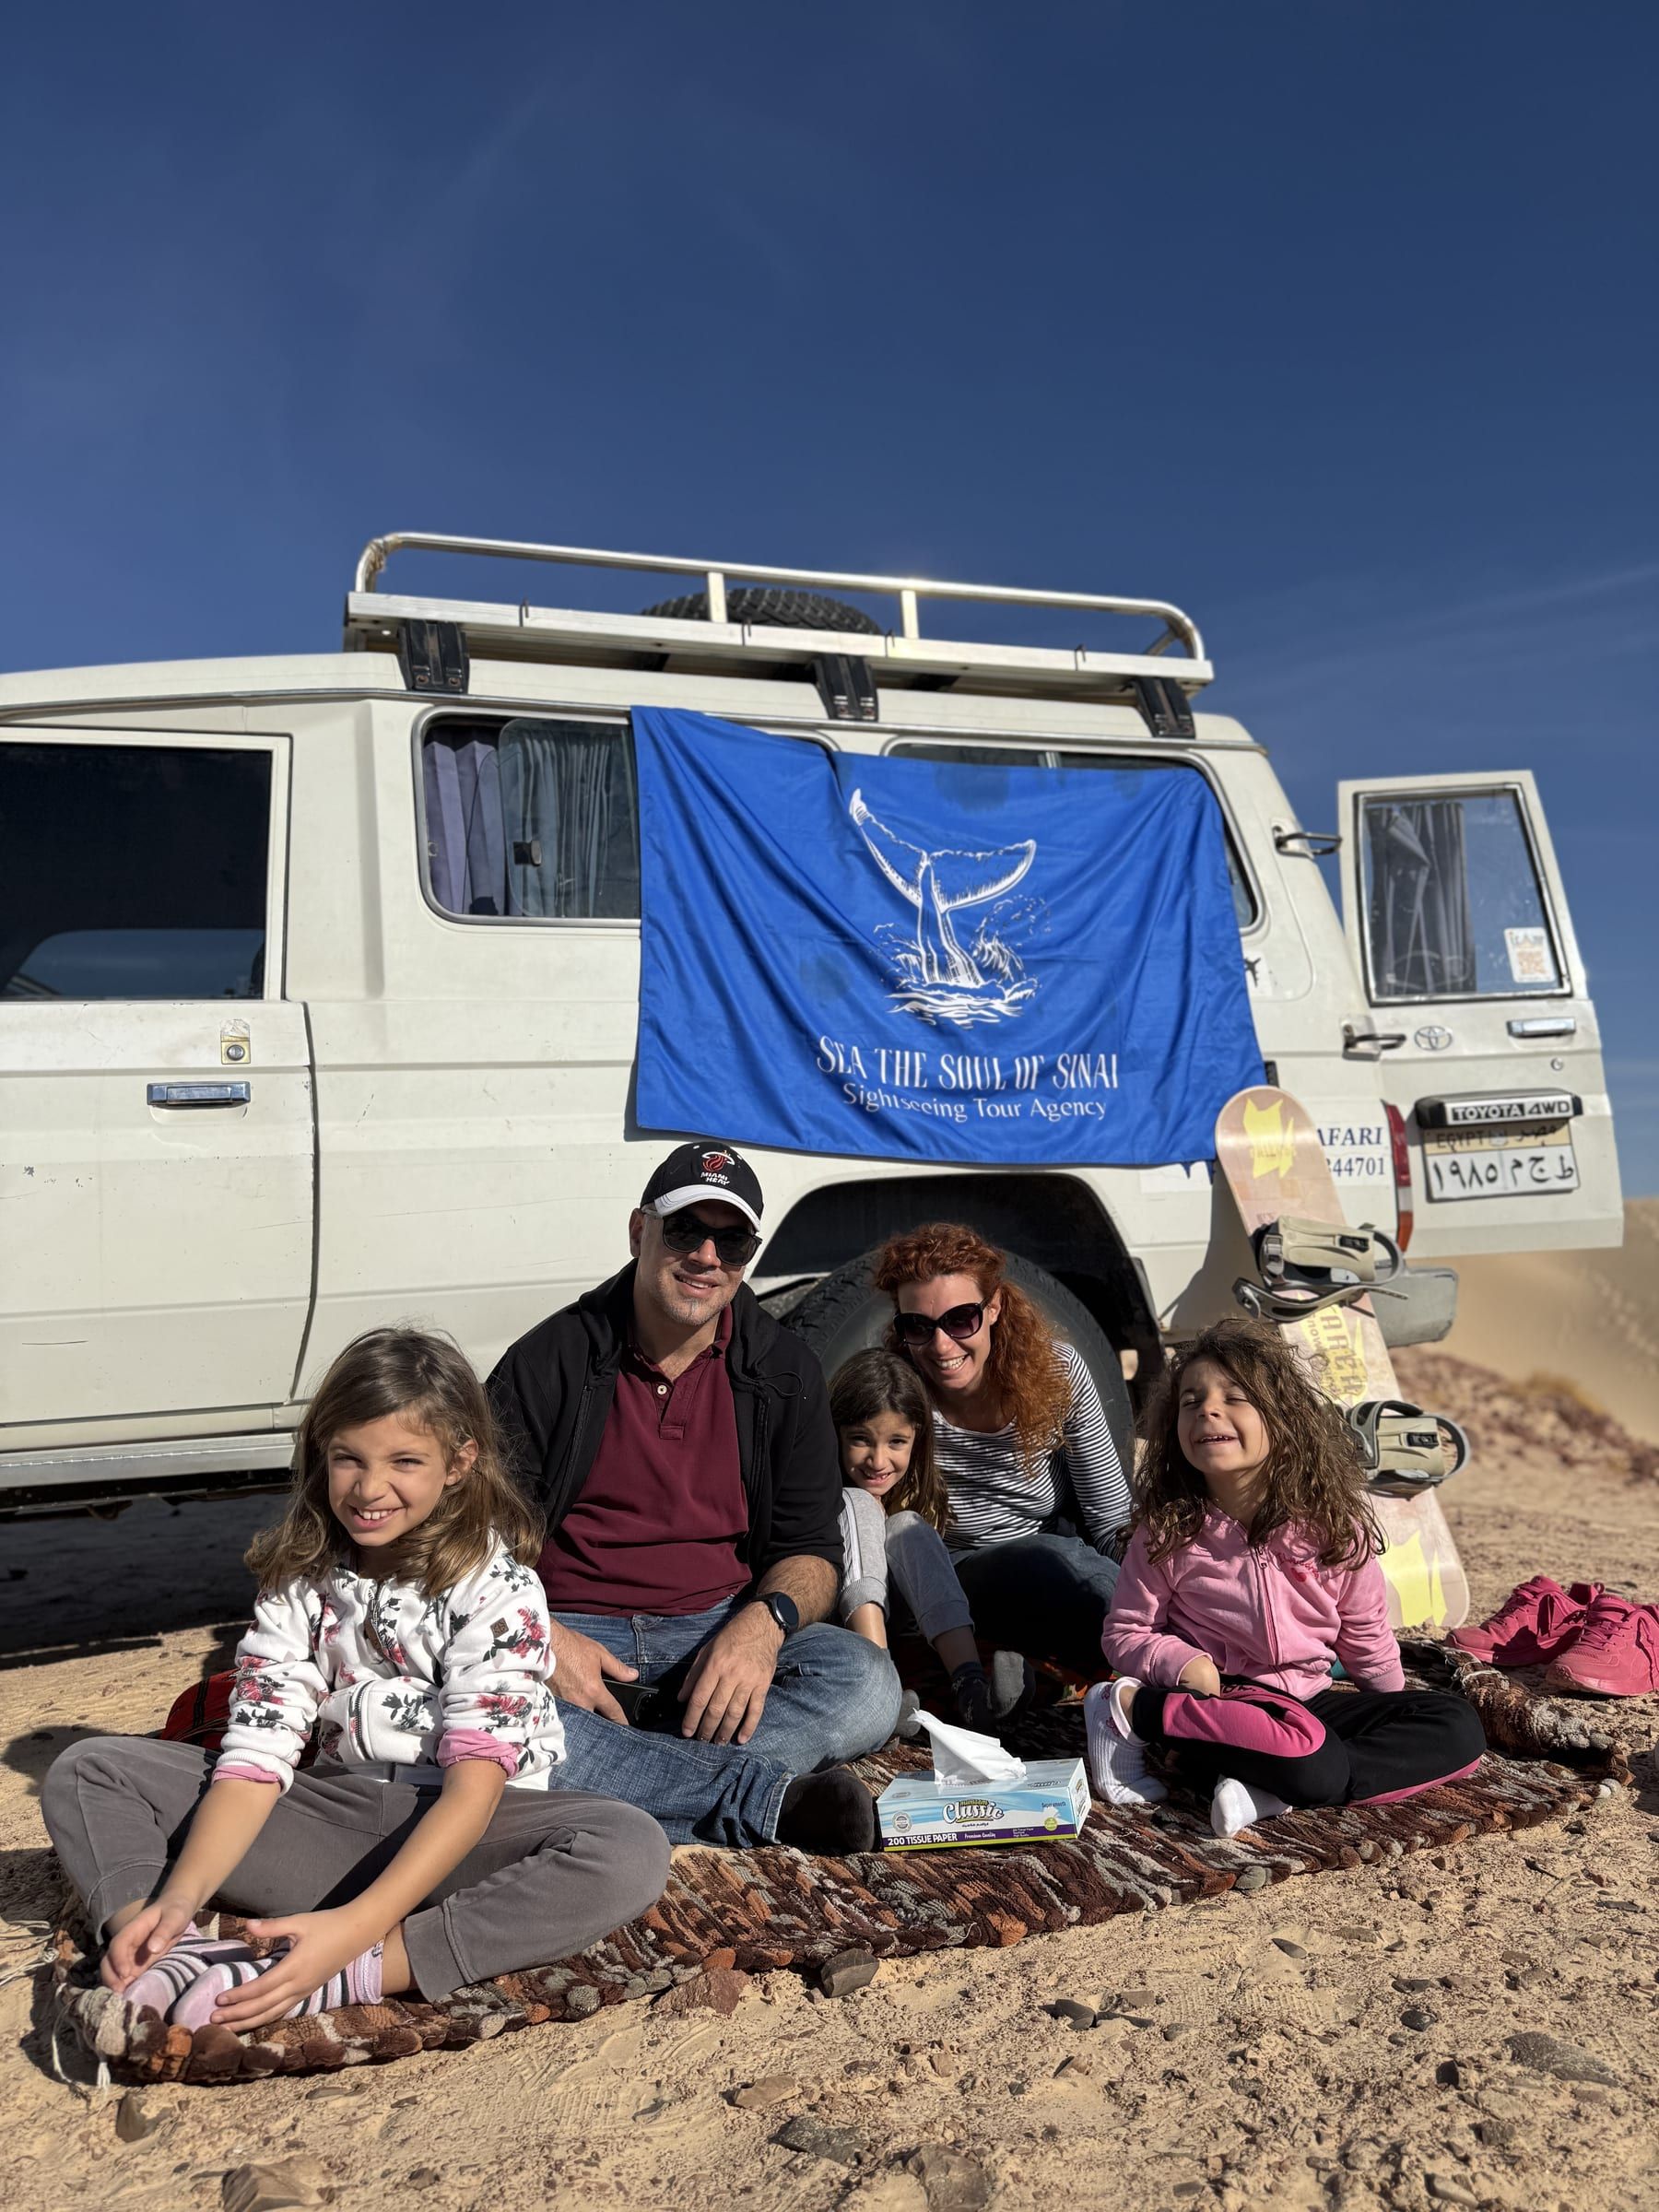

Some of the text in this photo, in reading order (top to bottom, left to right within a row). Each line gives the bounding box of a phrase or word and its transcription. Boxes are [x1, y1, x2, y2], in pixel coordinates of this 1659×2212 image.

[875, 1048, 928, 1088] THE
[938, 1053, 1006, 1090] SOUL
[1014, 1054, 1045, 1090] OF
[1053, 1053, 1119, 1089] SINAI
[843, 1082, 1107, 1124] Sightseeing Tour Agency
[1453, 1100, 1571, 1121] TOYOTA 4WD
[1436, 1130, 1484, 1149] EGYPT
[700, 1171, 728, 1181] MIAMI
[705, 1177, 730, 1185] HEAT
[942, 1800, 1005, 1824] Classic
[888, 1832, 958, 1846] 200 TISSUE PAPER
